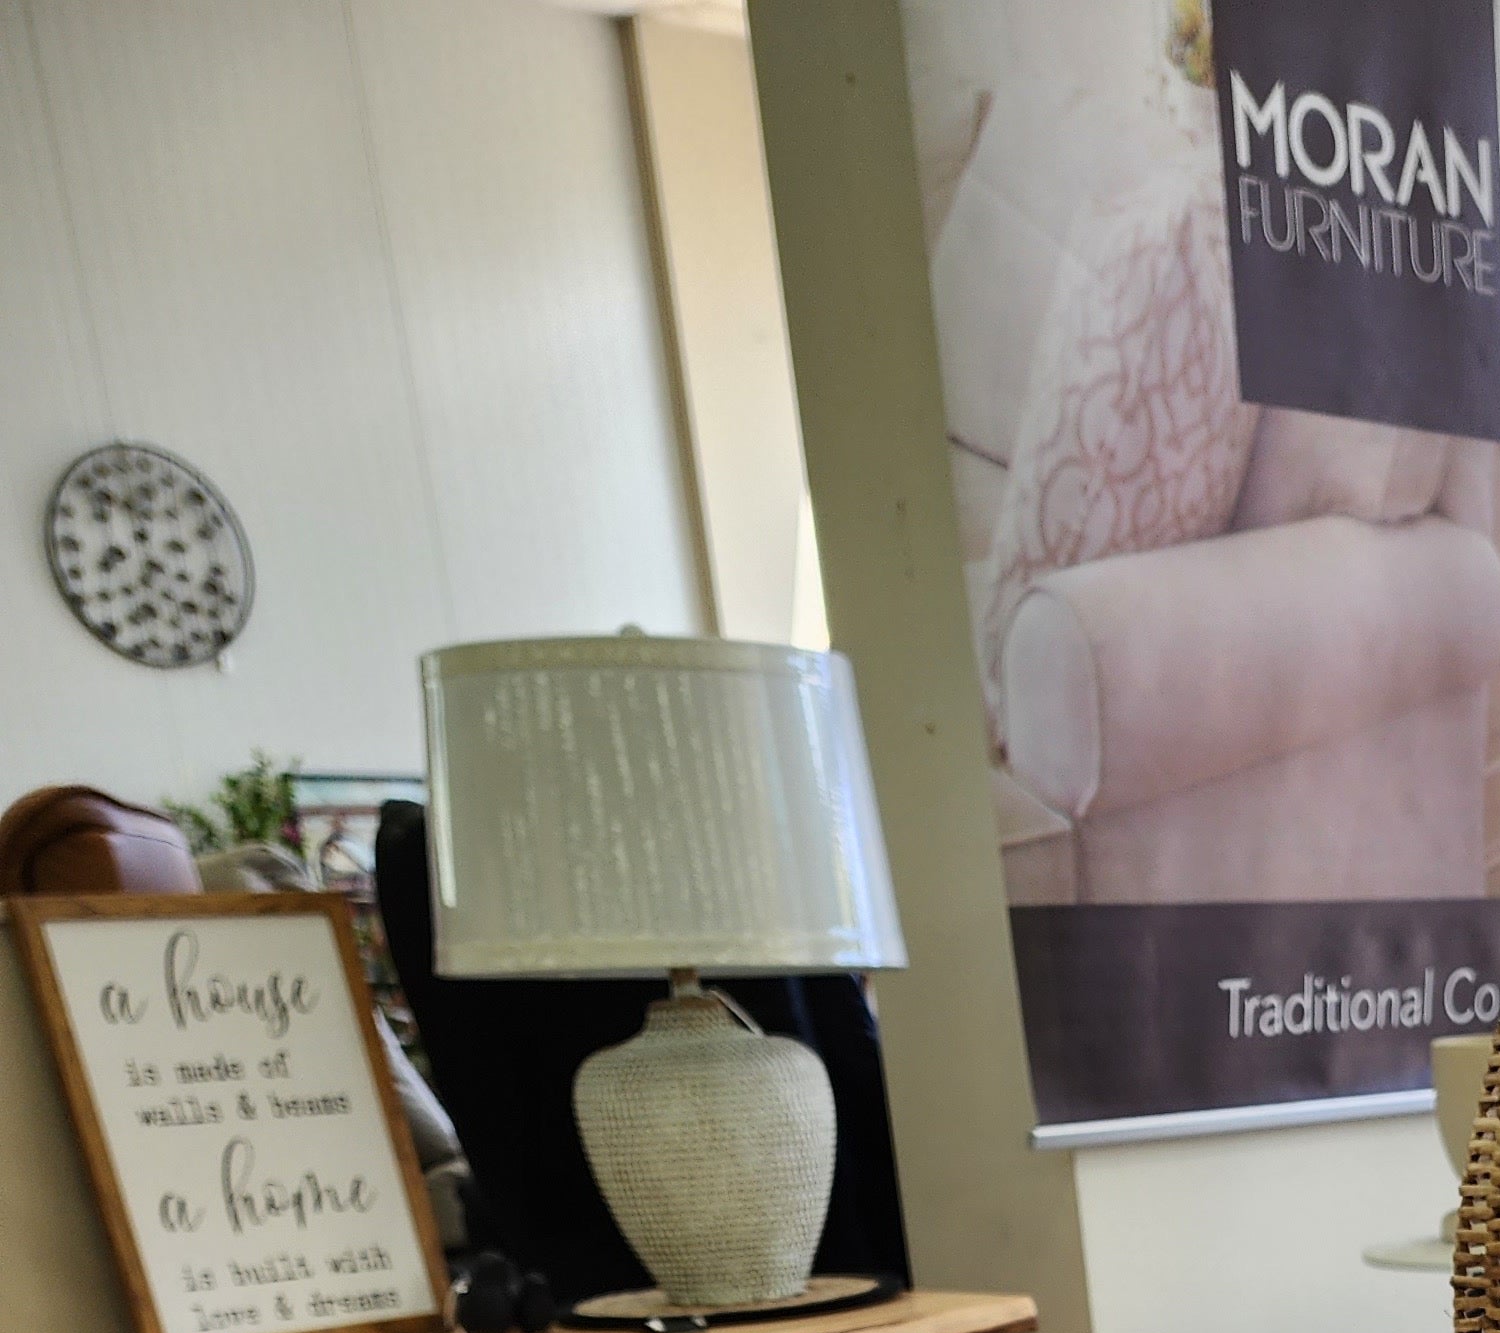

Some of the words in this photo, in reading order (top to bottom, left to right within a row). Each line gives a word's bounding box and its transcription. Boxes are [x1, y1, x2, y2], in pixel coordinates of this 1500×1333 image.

[1230, 70, 1494, 227] MORAN
[1239, 175, 1498, 297] FURNITURE
[100, 979, 148, 1025] a
[165, 931, 317, 1036] house
[1218, 967, 1433, 1038] Traditional
[125, 1057, 161, 1087] is
[174, 1053, 246, 1084] made
[258, 1049, 291, 1078] of
[135, 1096, 224, 1126] walls
[267, 1091, 351, 1119] beams
[158, 1191, 204, 1233] a
[221, 1137, 377, 1232] home
[181, 1262, 216, 1292] is
[227, 1256, 314, 1288] built
[325, 1243, 393, 1274] with
[191, 1303, 260, 1331] love
[306, 1288, 399, 1317] dreams
